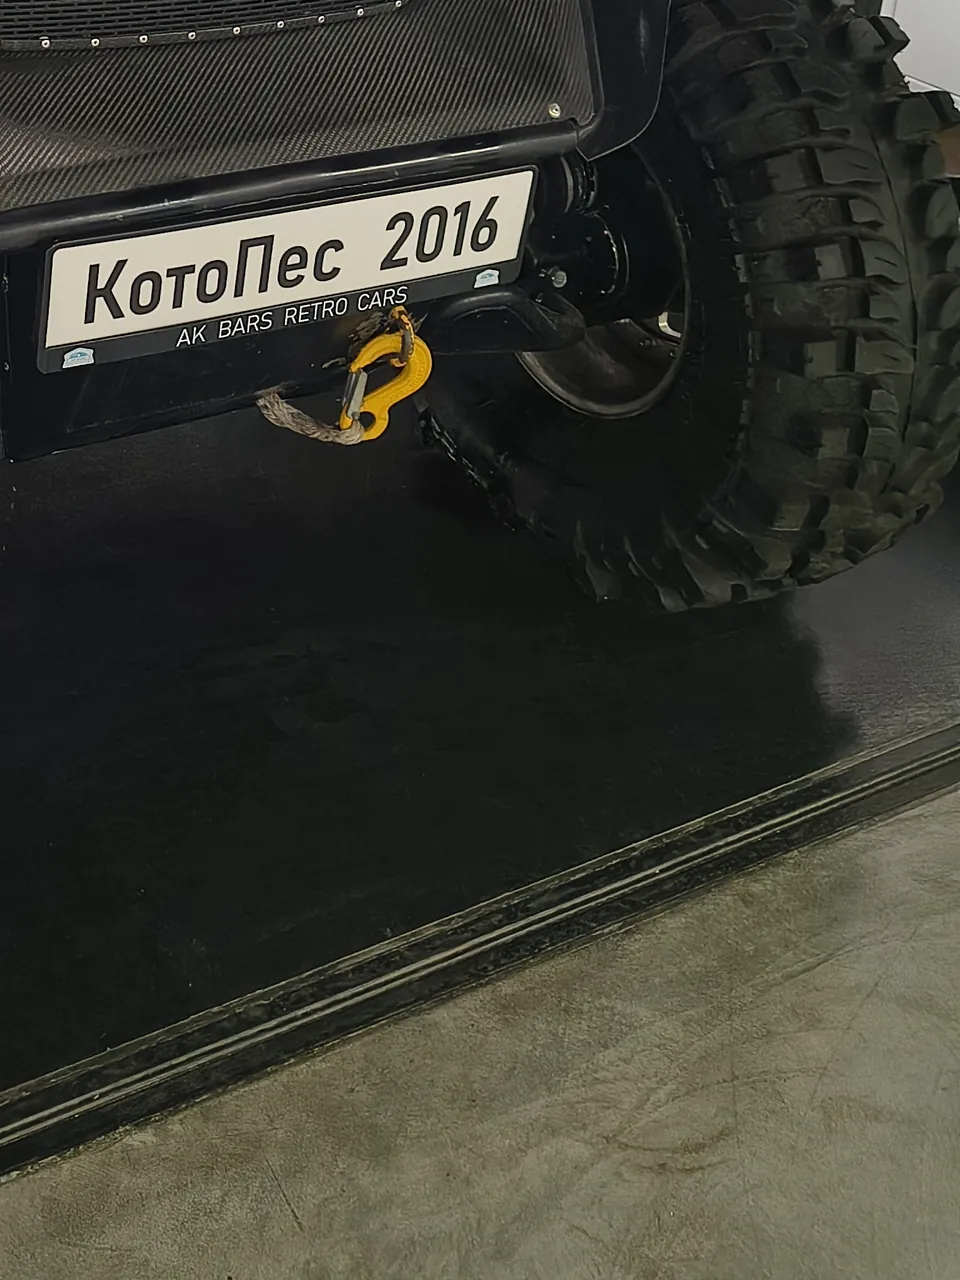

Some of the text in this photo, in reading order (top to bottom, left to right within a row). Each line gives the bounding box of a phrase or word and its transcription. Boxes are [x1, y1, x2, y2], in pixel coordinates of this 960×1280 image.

[83, 195, 500, 325] КотоПес 2016
[176, 285, 409, 348] AK BARS RETRO CARS
